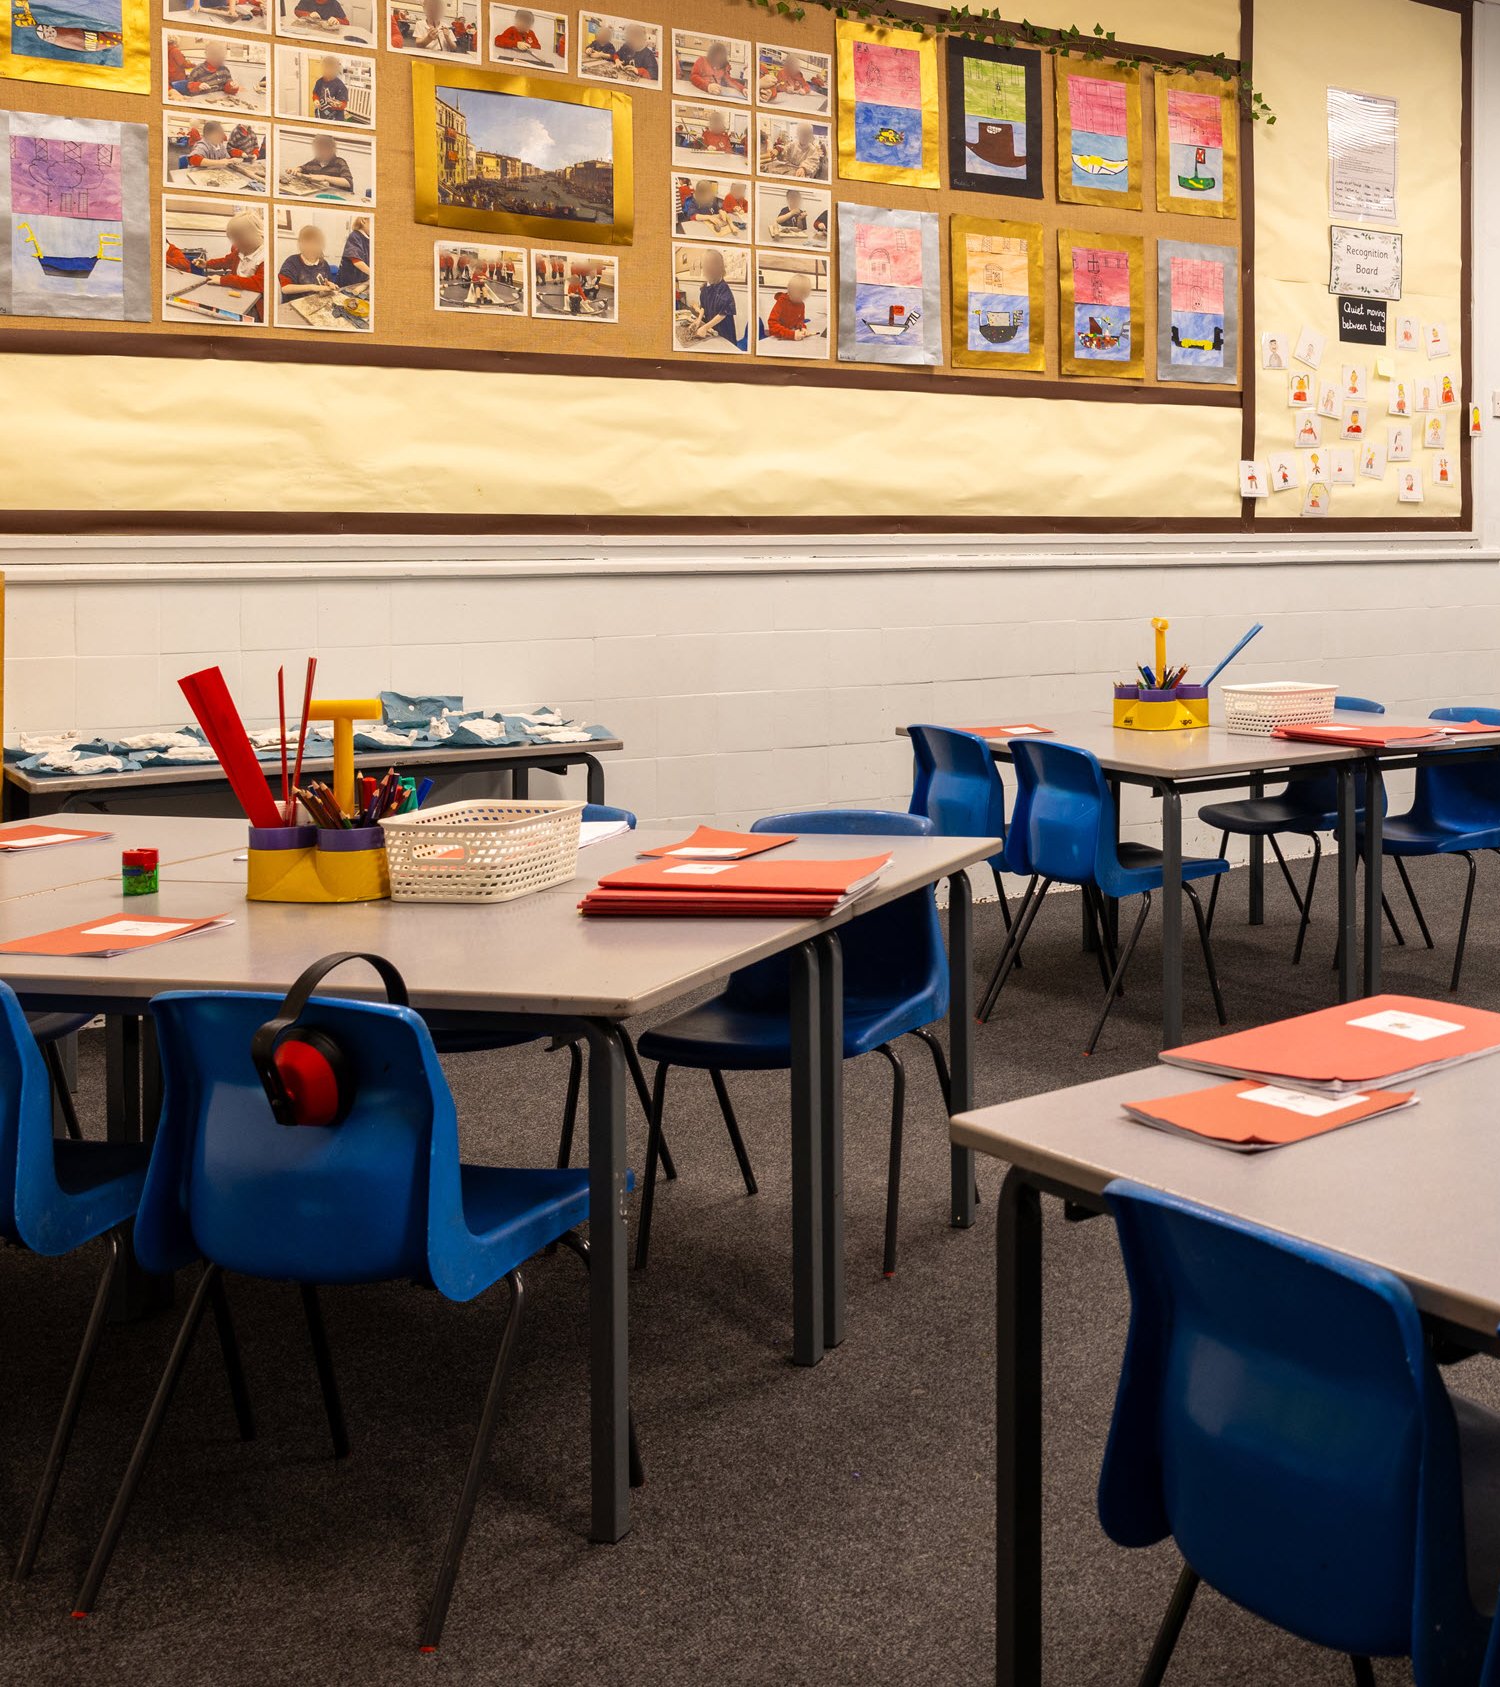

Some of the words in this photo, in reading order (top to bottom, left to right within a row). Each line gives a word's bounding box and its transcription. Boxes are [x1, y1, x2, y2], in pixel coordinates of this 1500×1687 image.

[1346, 244, 1389, 260] Recognition
[1355, 263, 1379, 276] Board
[1343, 301, 1365, 316] Quiet
[1366, 309, 1386, 323] moving
[1341, 316, 1368, 331] between
[1369, 320, 1385, 333] tasks
